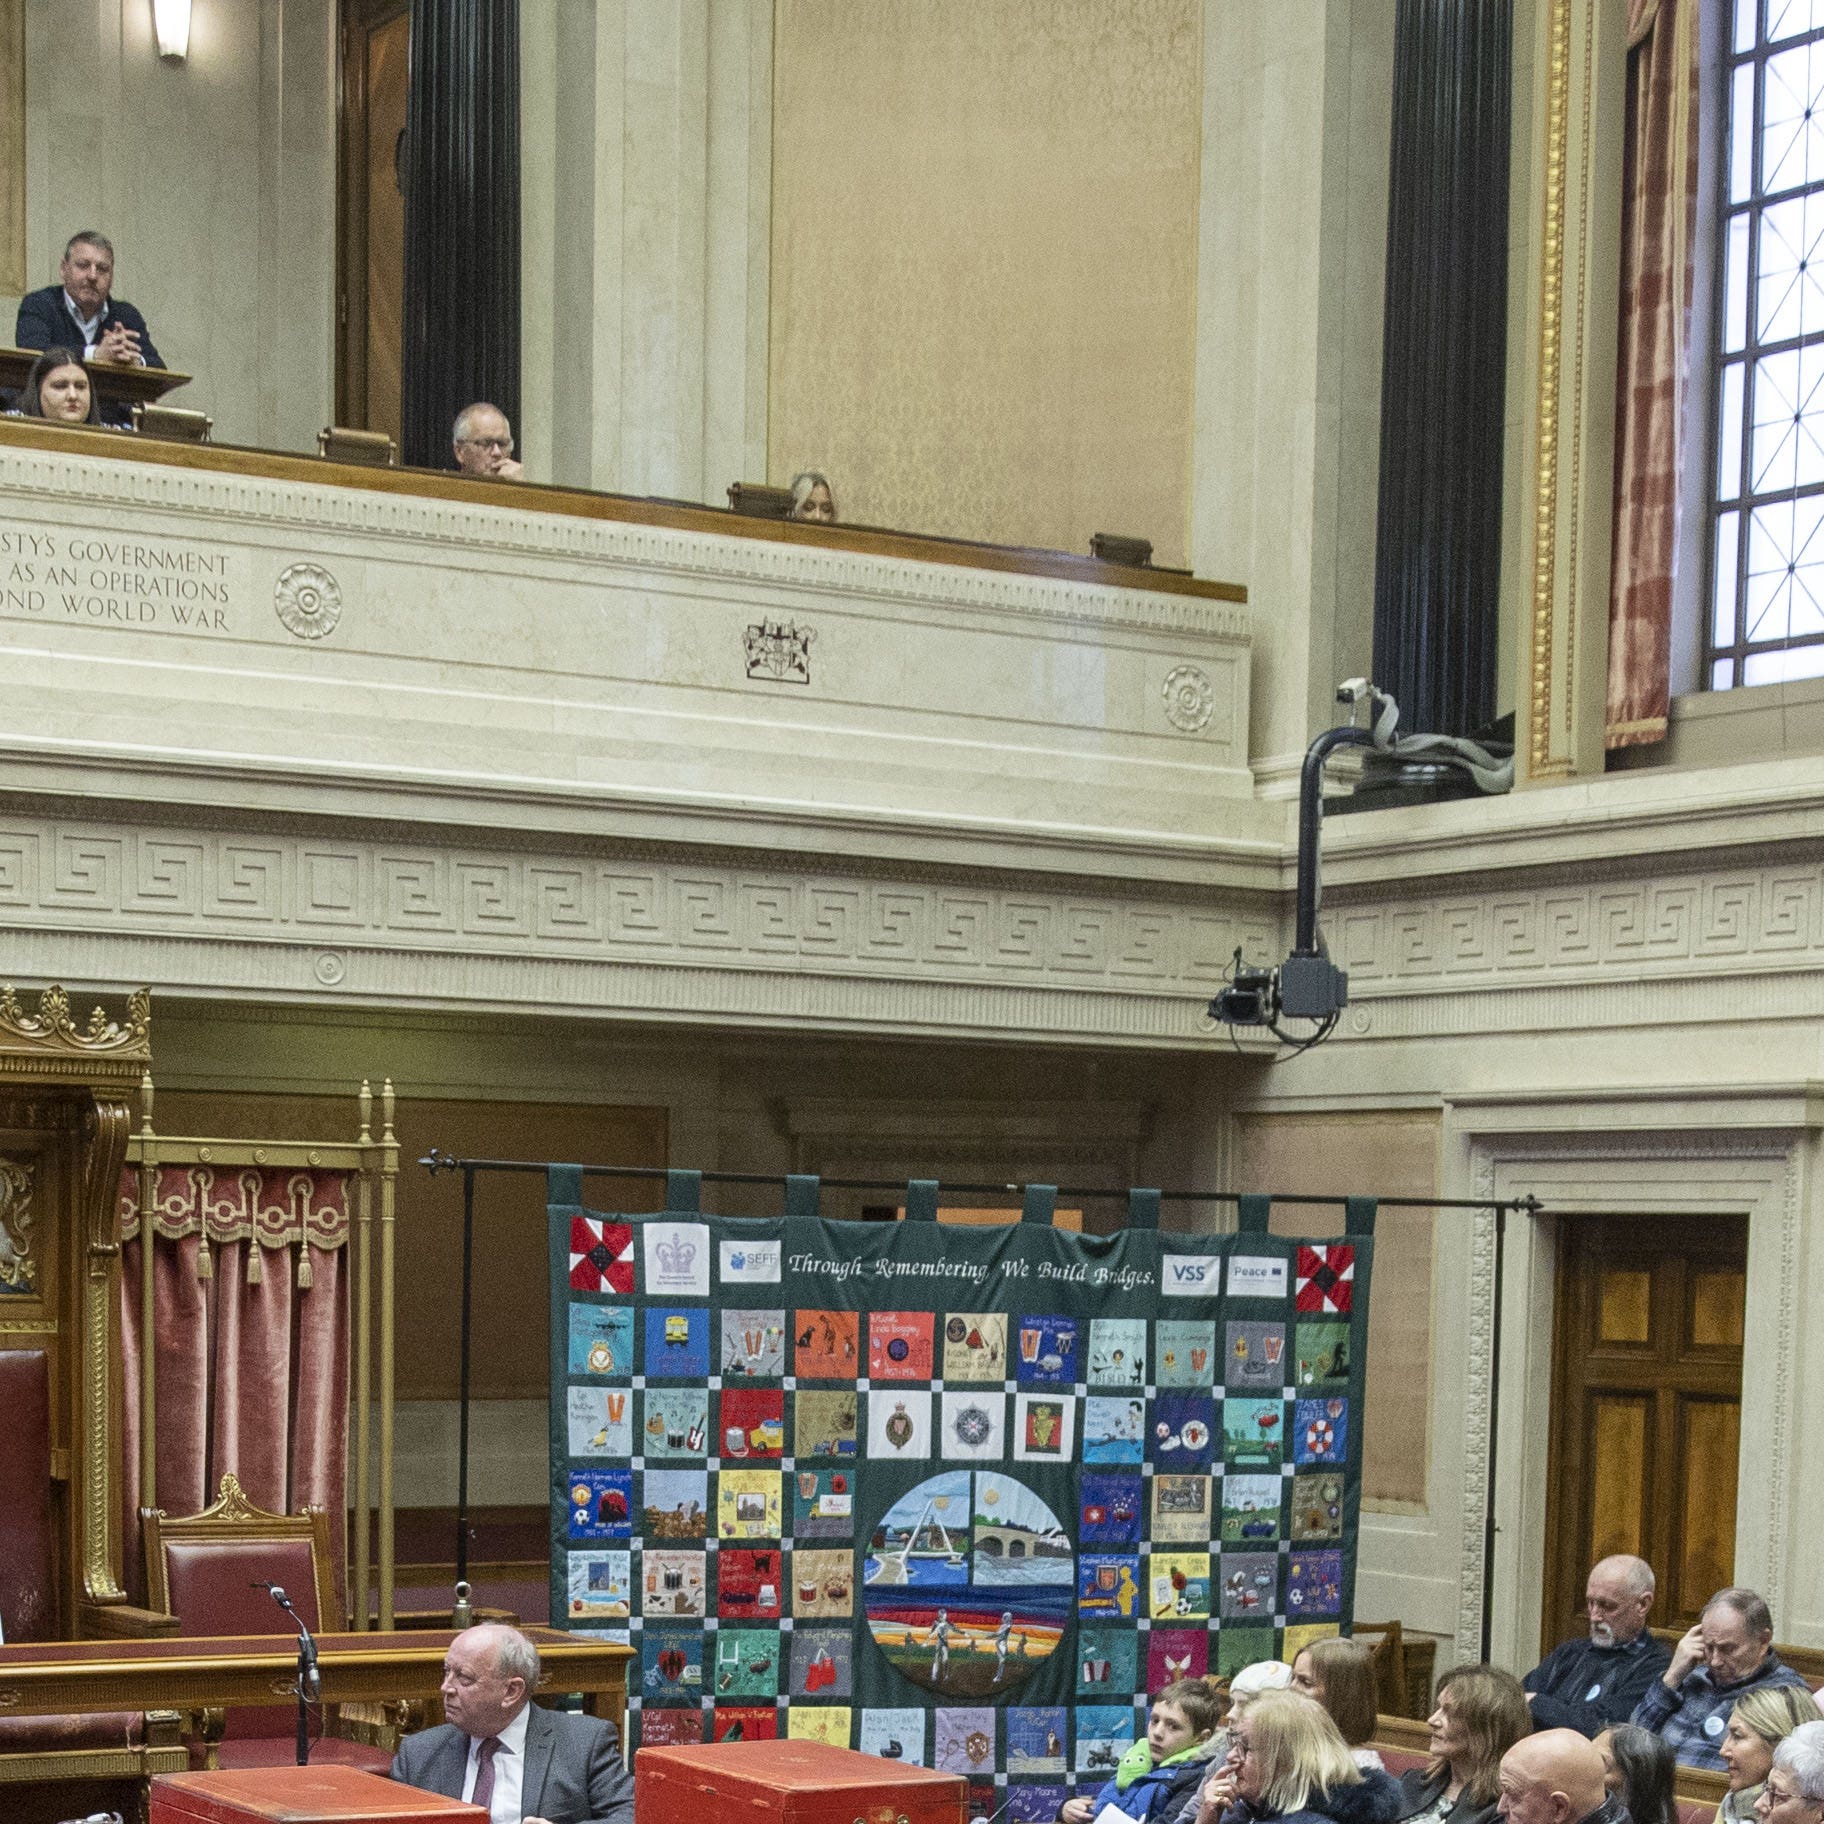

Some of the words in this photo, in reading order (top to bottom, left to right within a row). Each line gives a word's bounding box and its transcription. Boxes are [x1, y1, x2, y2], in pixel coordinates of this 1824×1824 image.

[68, 540, 229, 576] GOVERNMENT
[9, 562, 35, 582] AS
[45, 567, 77, 586] AN
[90, 570, 229, 603] OPERATIONS
[61, 594, 156, 621] WORLD
[171, 605, 229, 632] WAR
[747, 1252, 777, 1265] SEFF
[788, 1252, 863, 1282] Through
[875, 1256, 990, 1285] Remembering,
[1002, 1257, 1030, 1278] We
[1038, 1261, 1086, 1282] Build
[1094, 1264, 1156, 1291] Bridges.
[1173, 1264, 1206, 1282] VSS
[1235, 1266, 1268, 1277] Peace
